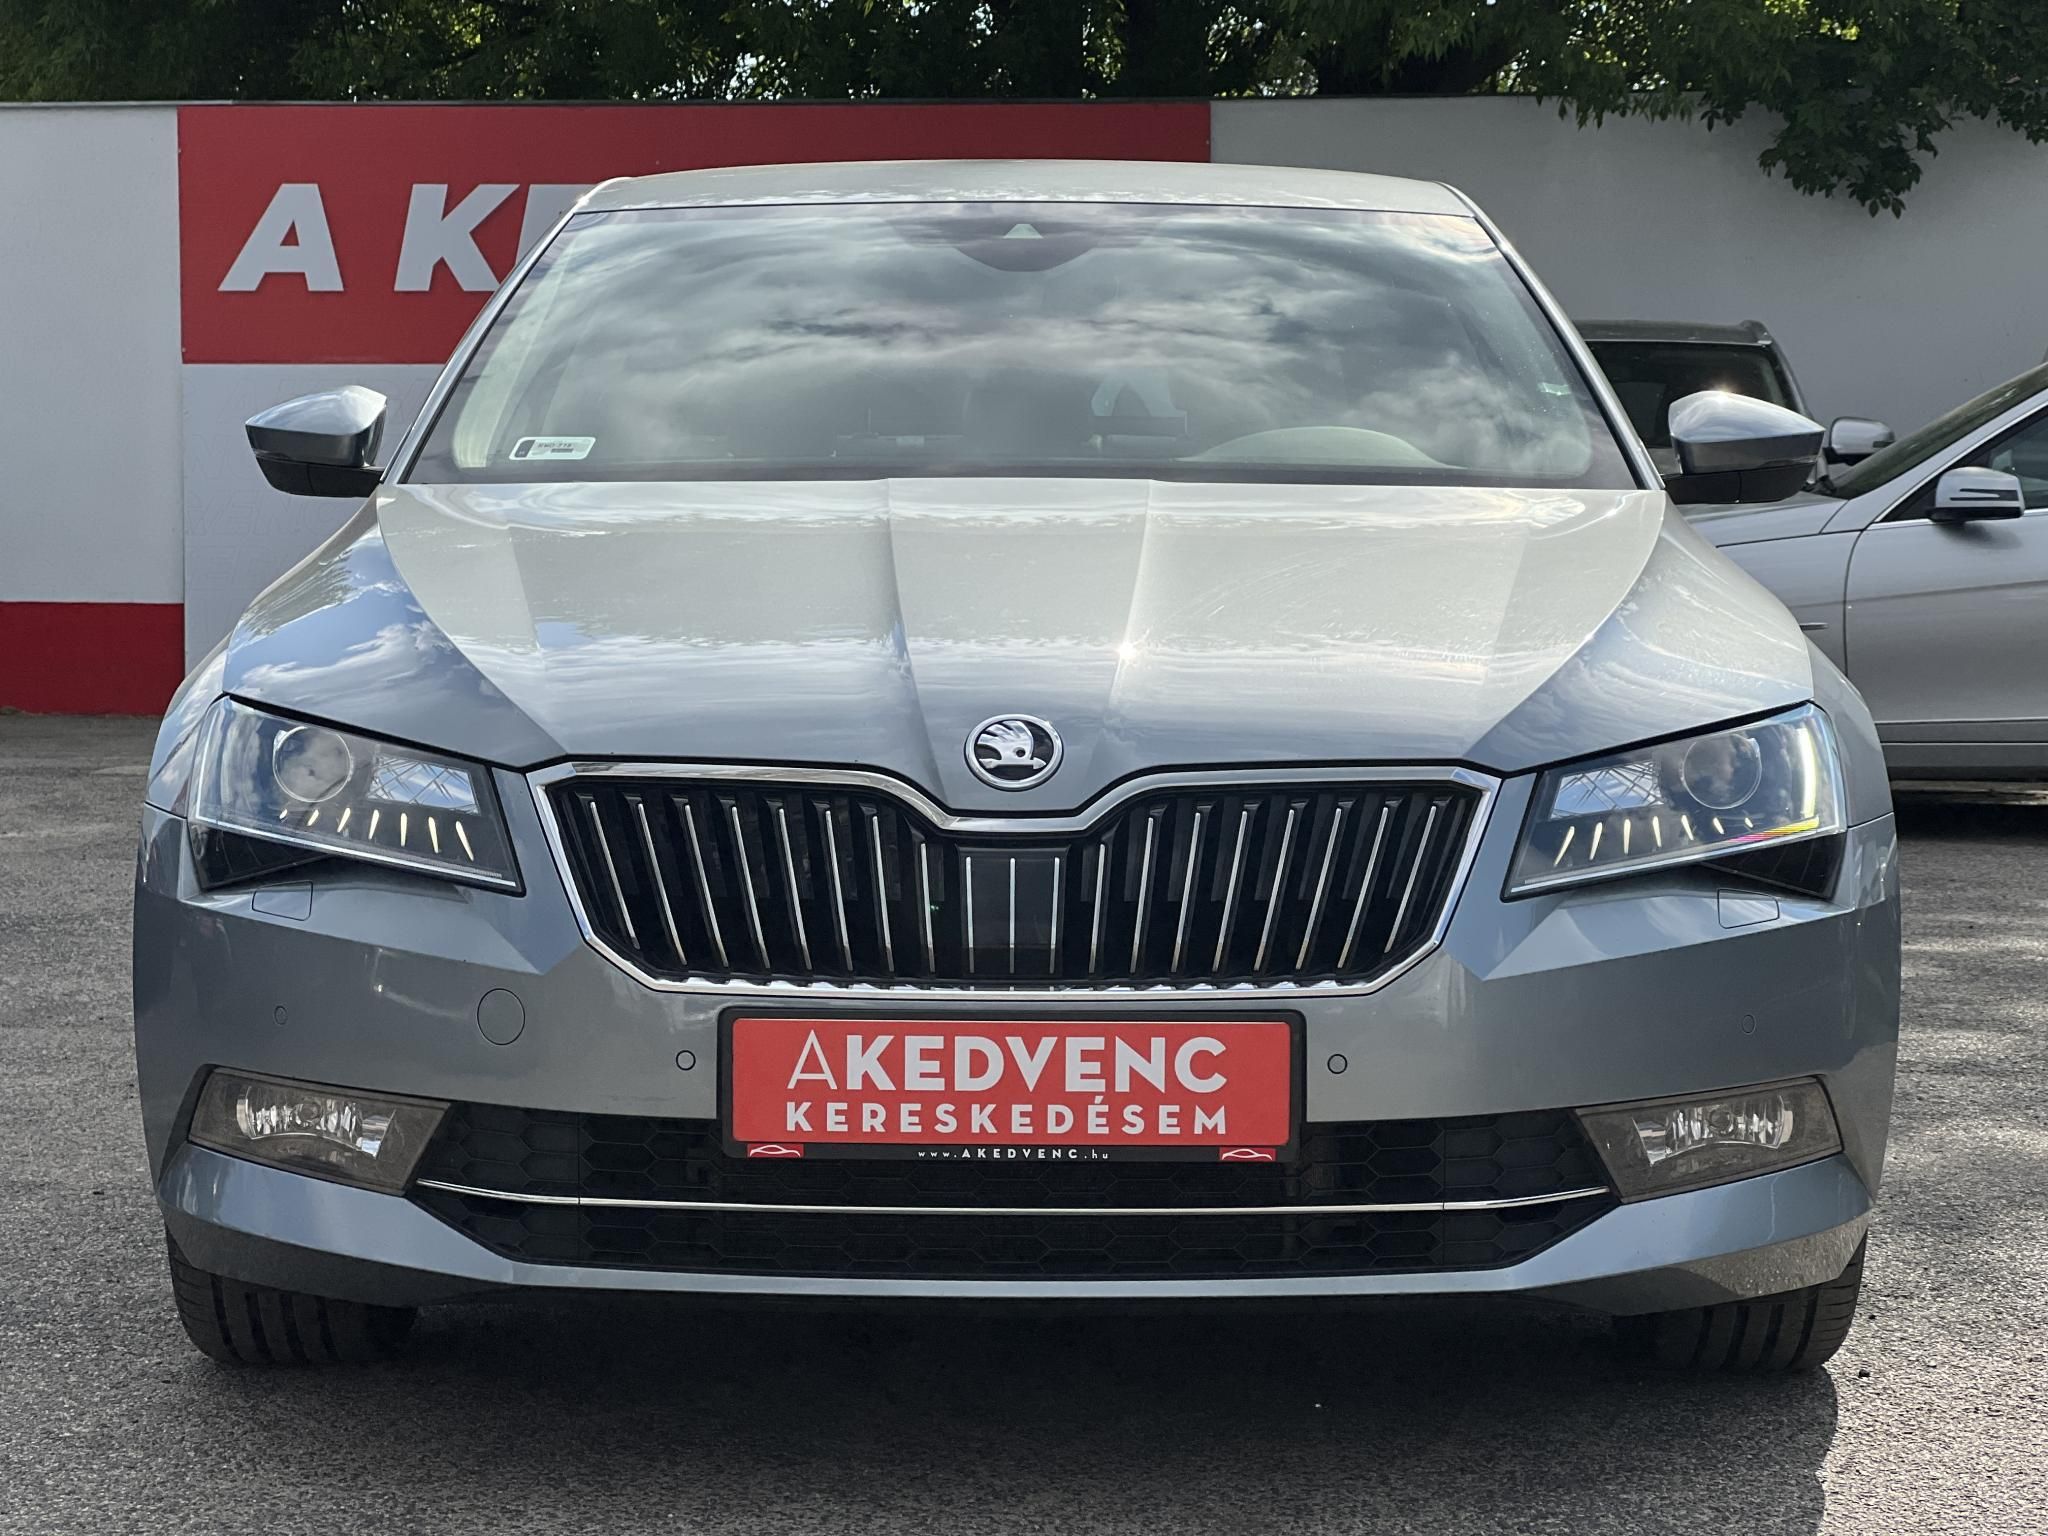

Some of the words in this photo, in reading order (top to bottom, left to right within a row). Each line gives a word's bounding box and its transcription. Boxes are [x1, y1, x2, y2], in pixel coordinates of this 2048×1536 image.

[218, 183, 344, 292] A
[786, 1028, 1228, 1094] AKEDVENC
[786, 1095, 1227, 1135] KERESKEDÉSEM
[917, 1148, 1110, 1160] www.AKEDVENC.hu
